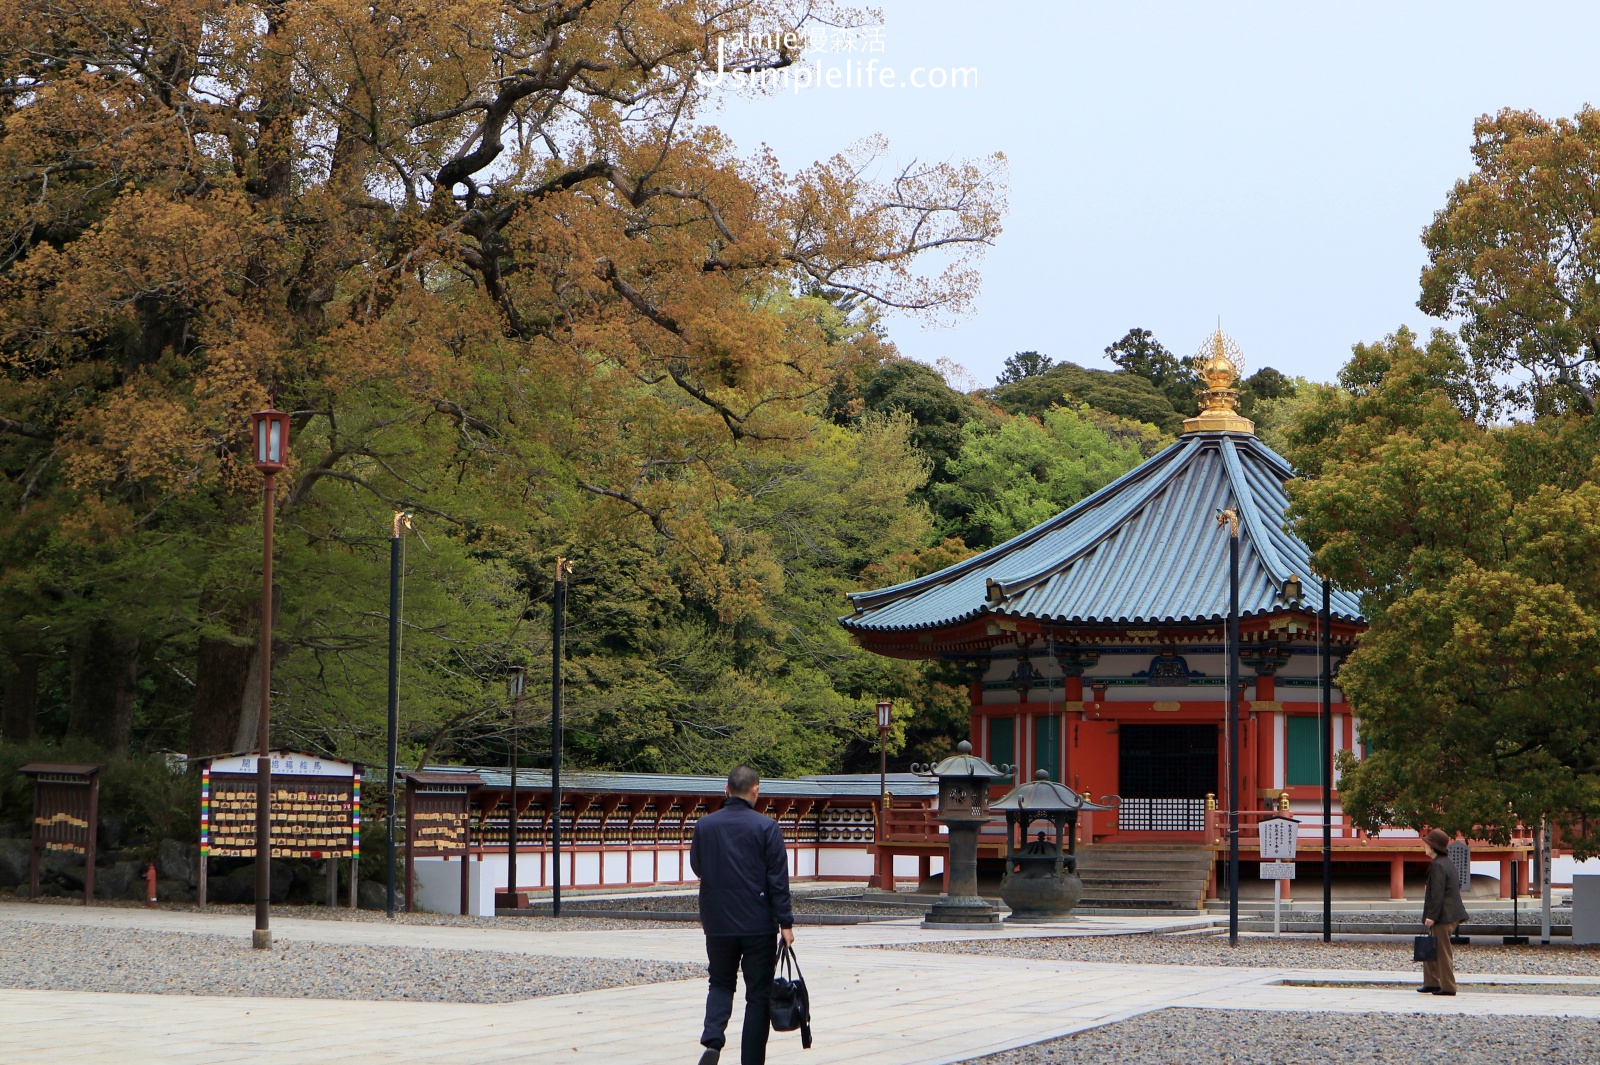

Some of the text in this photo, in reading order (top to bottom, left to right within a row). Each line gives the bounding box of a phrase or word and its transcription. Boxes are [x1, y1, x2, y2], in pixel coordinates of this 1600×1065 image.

[242, 759, 321, 770] 開招福絵馬
